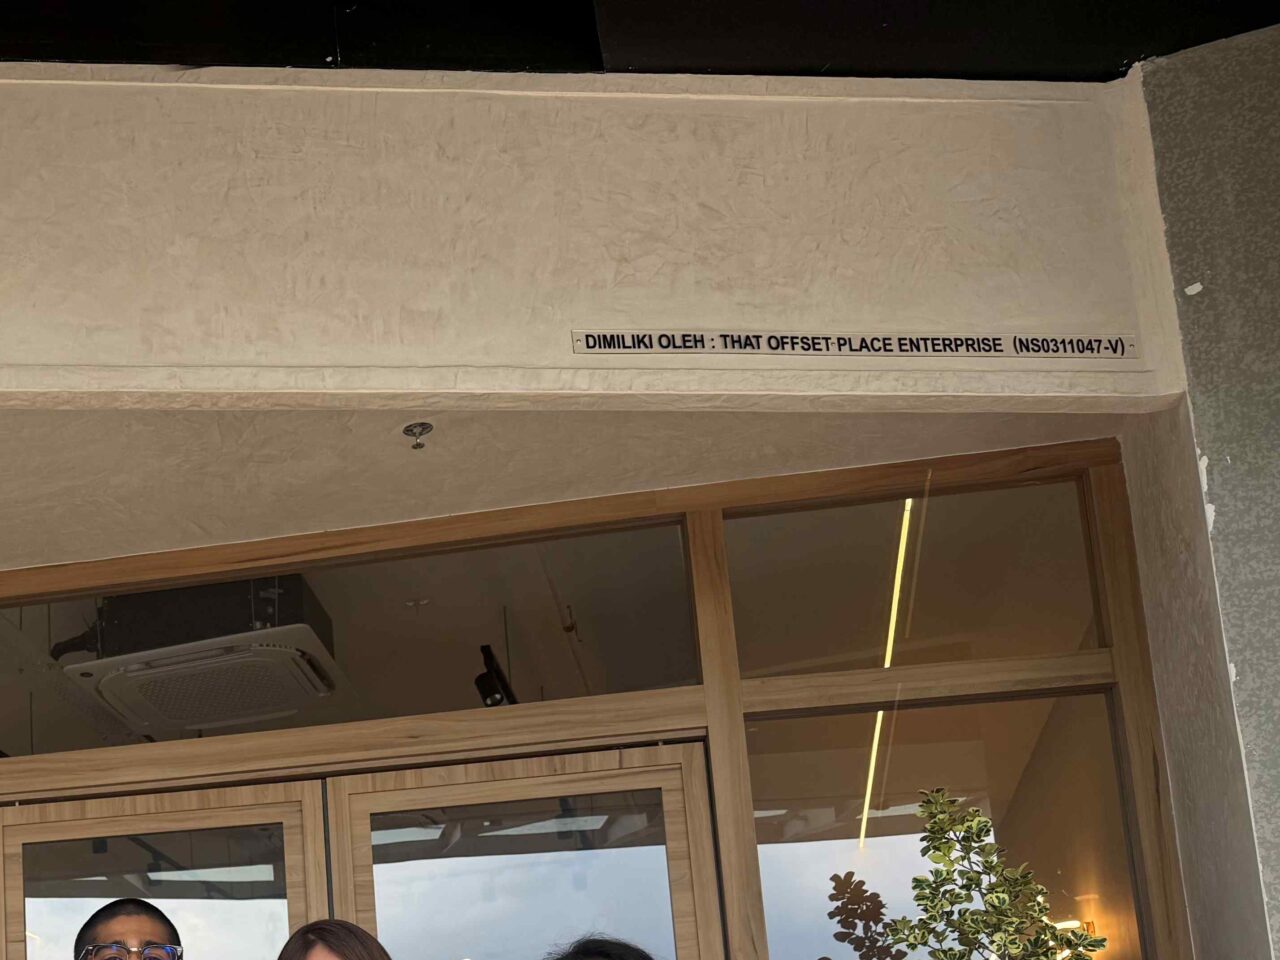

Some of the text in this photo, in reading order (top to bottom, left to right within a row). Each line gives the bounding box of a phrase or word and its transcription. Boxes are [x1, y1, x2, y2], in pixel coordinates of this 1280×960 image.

[585, 334, 654, 349] DIMILIKI
[658, 334, 705, 349] OLEH
[720, 334, 762, 350] THAT
[767, 335, 831, 351] OFFSET
[837, 337, 892, 352] PLACE
[898, 337, 1004, 353] ENTERPRISE
[1013, 337, 1126, 356] (NS0311047-V)
